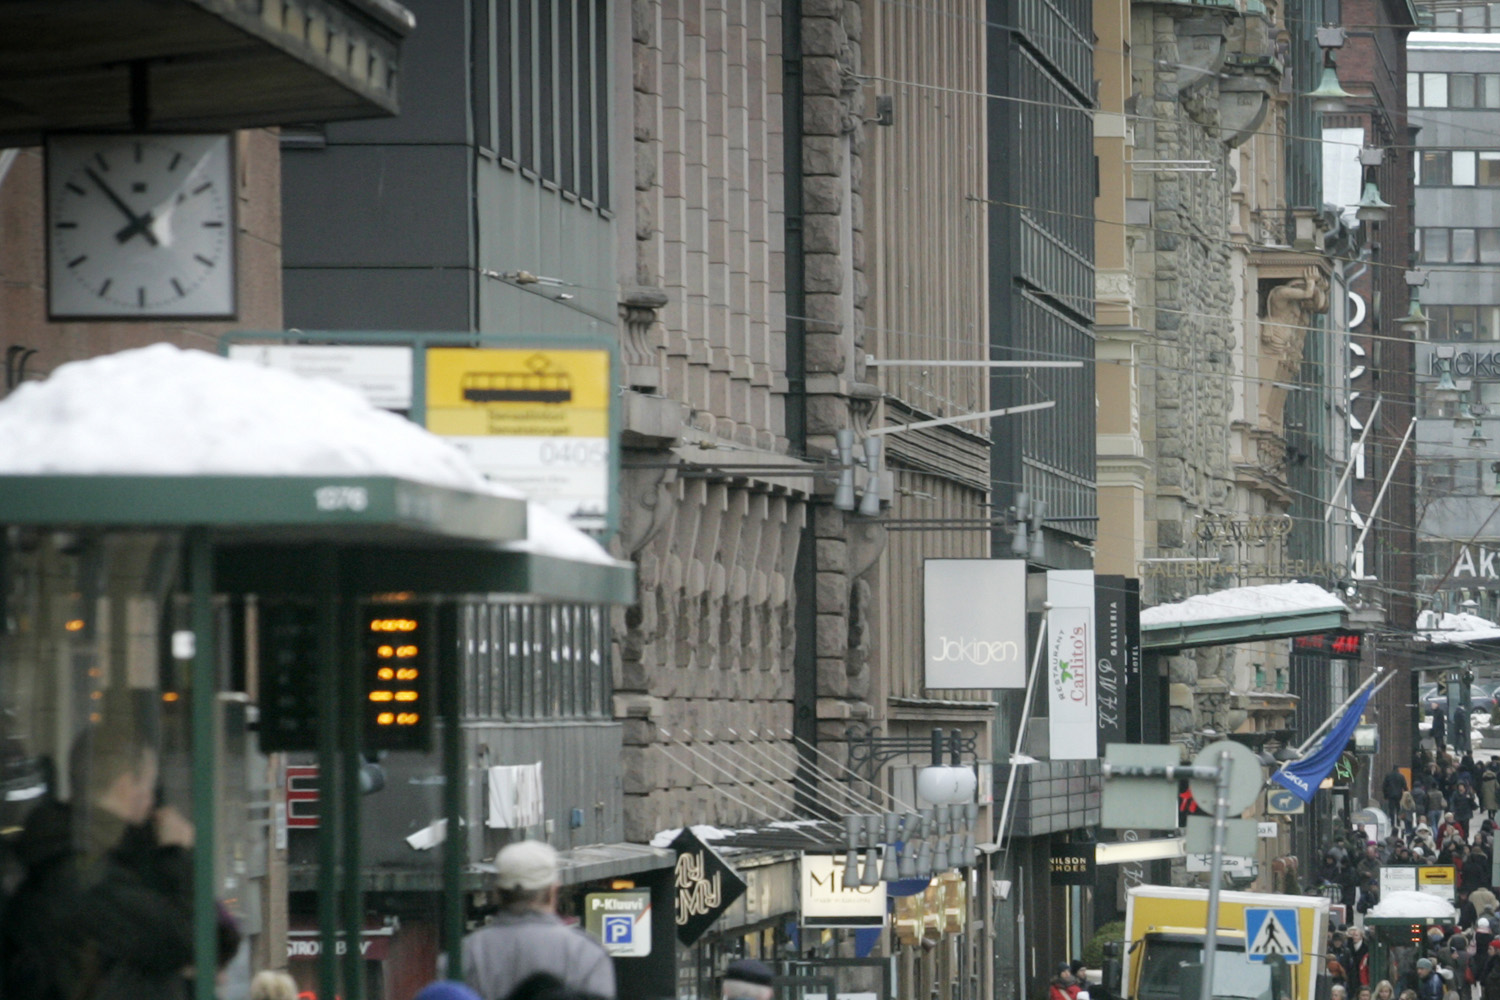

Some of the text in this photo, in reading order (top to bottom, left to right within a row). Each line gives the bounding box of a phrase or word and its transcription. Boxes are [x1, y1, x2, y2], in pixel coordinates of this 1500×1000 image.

[1110, 602, 1118, 656] GALLERIA
[932, 635, 1018, 665] Jokinen
[1053, 629, 1065, 700] RESTAURANT
[1069, 626, 1085, 702] Carlito's
[1283, 770, 1309, 791] OKIA
[1049, 857, 1087, 865] NILSON
[592, 899, 643, 910] P-Kluuvi
[612, 925, 627, 942] P
